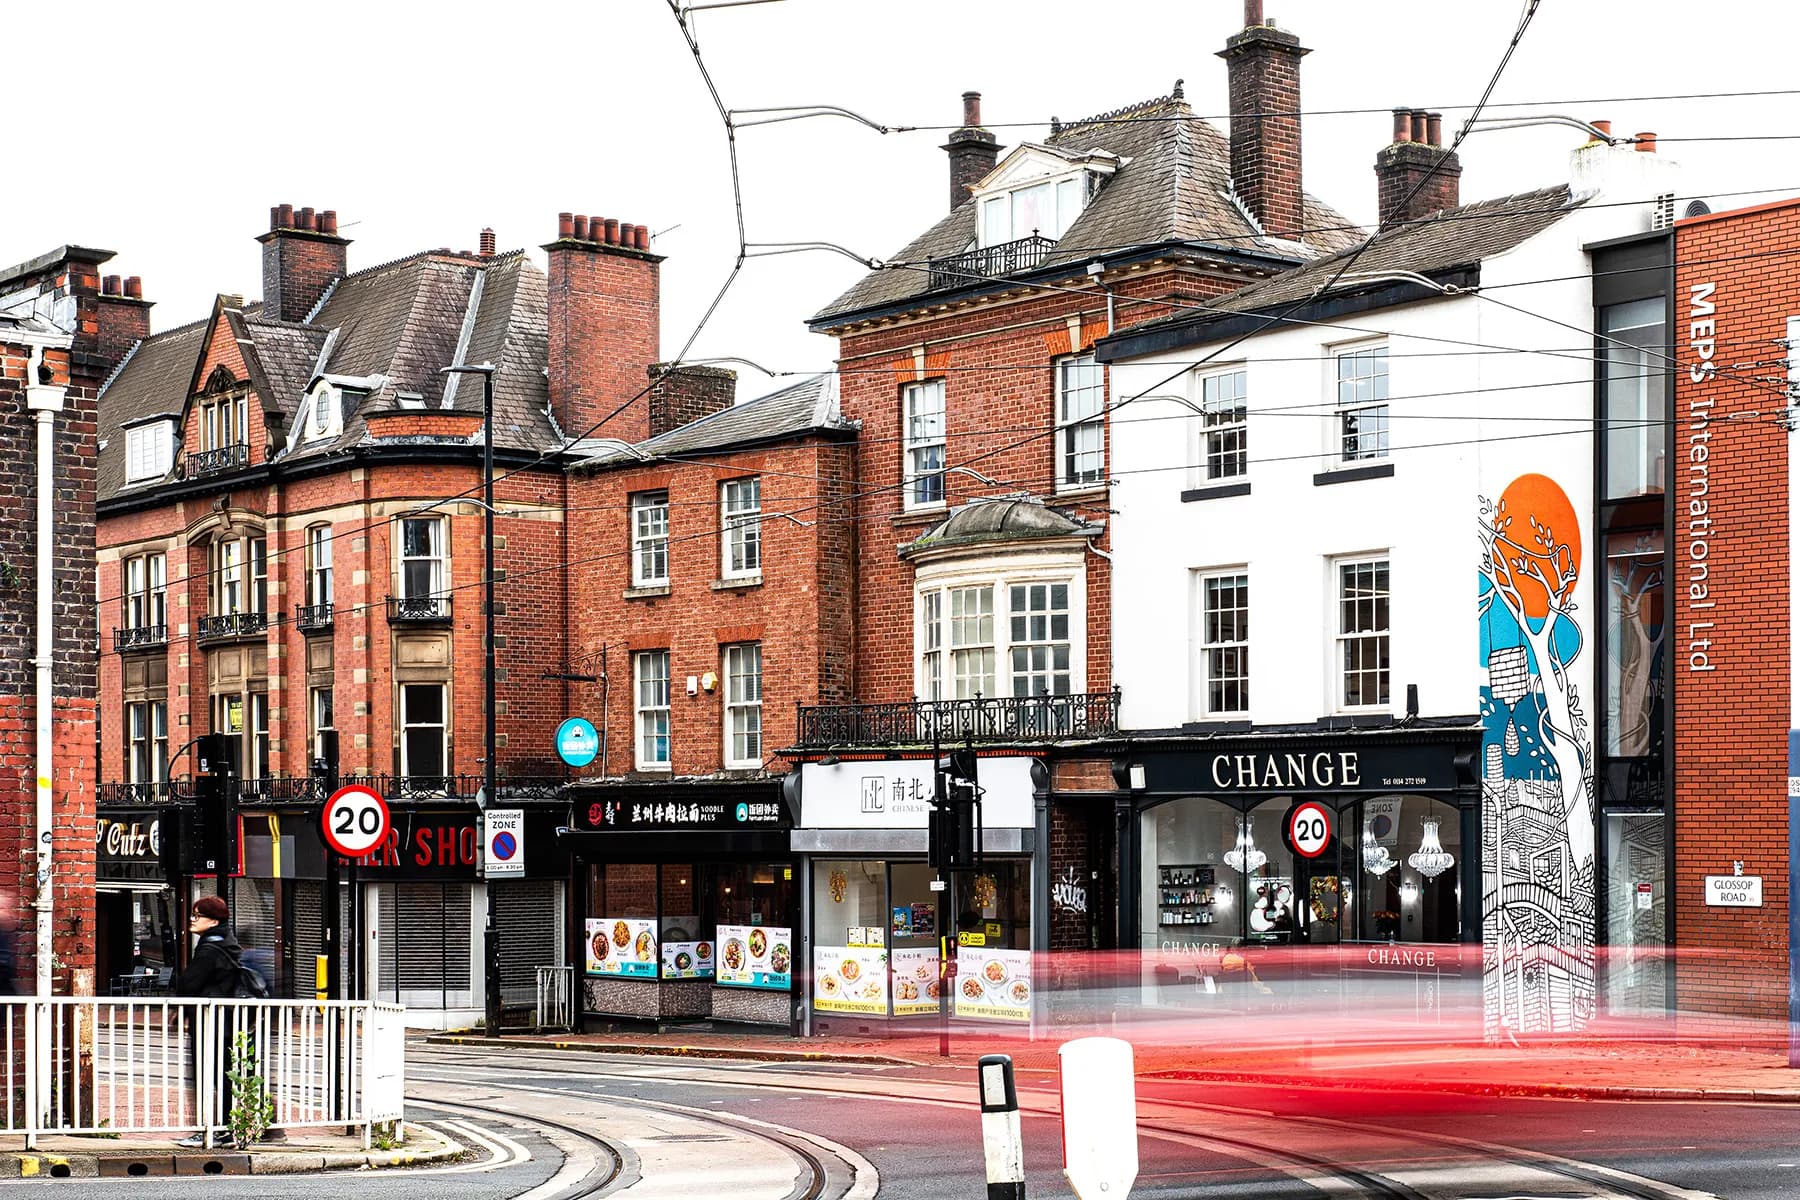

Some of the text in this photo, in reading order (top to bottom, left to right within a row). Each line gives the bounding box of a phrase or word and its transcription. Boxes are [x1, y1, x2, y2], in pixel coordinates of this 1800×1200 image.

[1689, 282, 1716, 671] MEPS International Ltd
[1212, 752, 1361, 788] CHANGE
[892, 777, 932, 801] 南北
[334, 806, 380, 835] 20
[631, 802, 700, 824] 兰州牛肉拉面
[492, 821, 516, 829] ZONE
[1297, 818, 1325, 841] 20
[415, 826, 476, 867] SHO
[1713, 880, 1754, 890] GLOSSOP
[1720, 892, 1747, 902] ROAD
[1161, 940, 1220, 957] CHANGE
[1367, 948, 1436, 967] CHANGE
